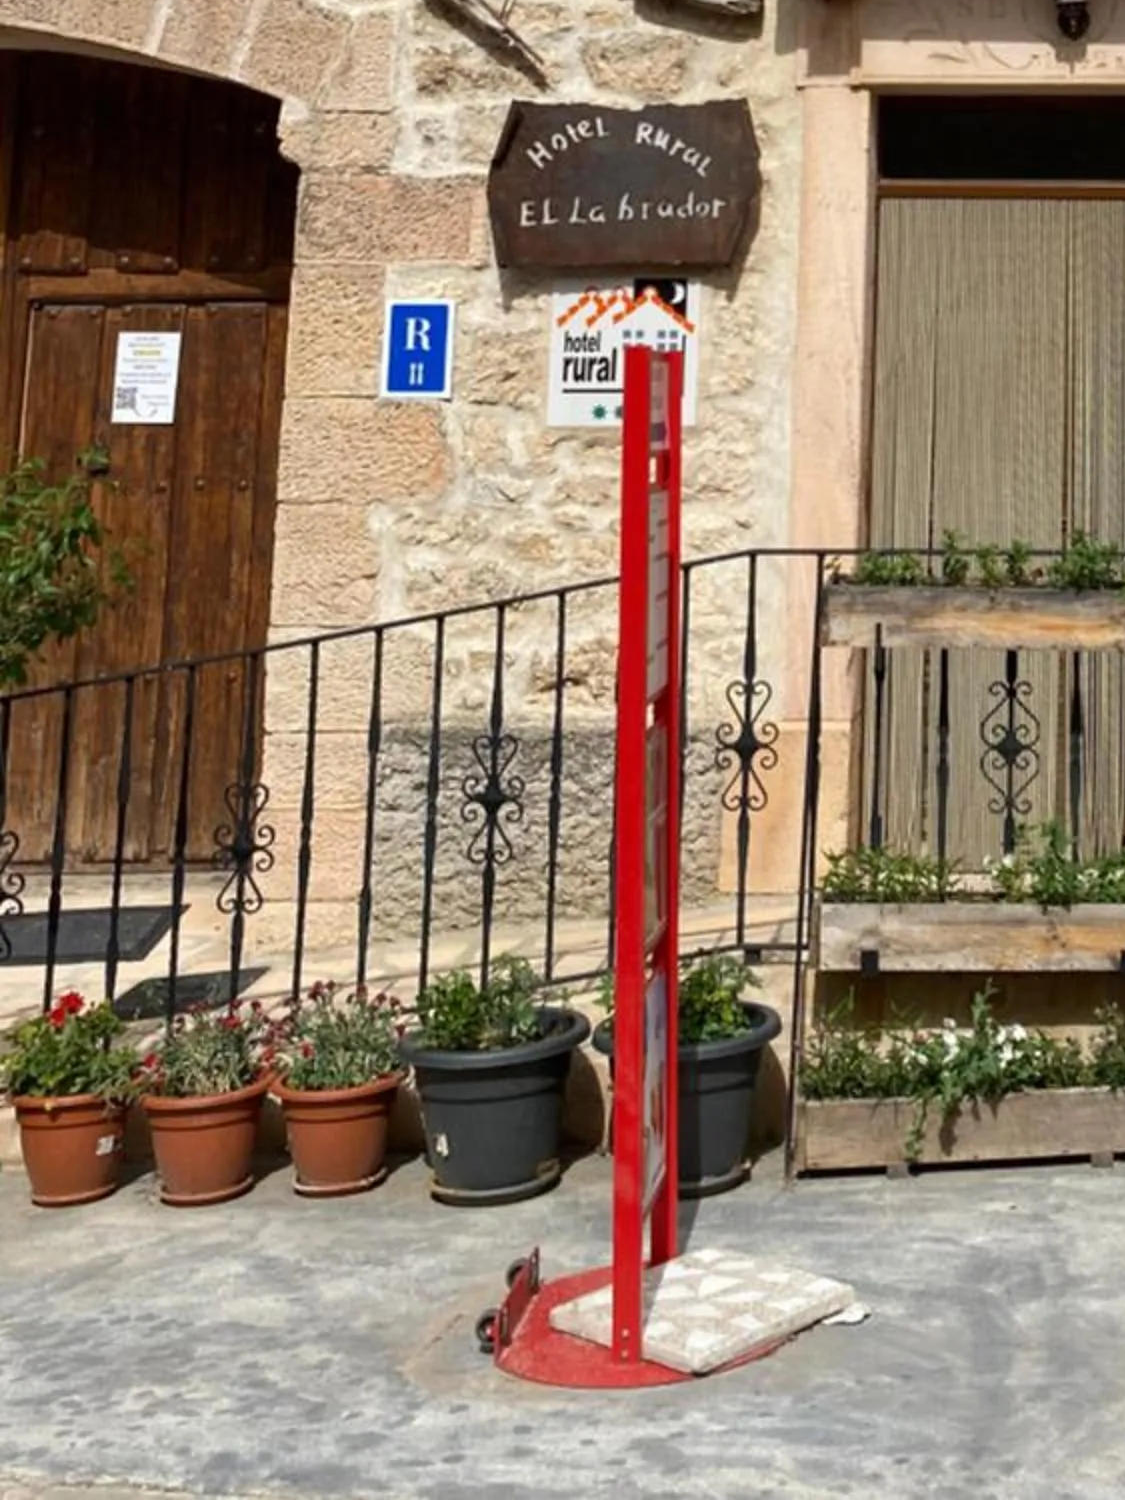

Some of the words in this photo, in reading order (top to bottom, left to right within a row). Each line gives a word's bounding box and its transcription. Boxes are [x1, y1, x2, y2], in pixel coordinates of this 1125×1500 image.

[403, 317, 432, 352] R
[563, 330, 602, 353] hotel
[562, 347, 618, 383] rural
